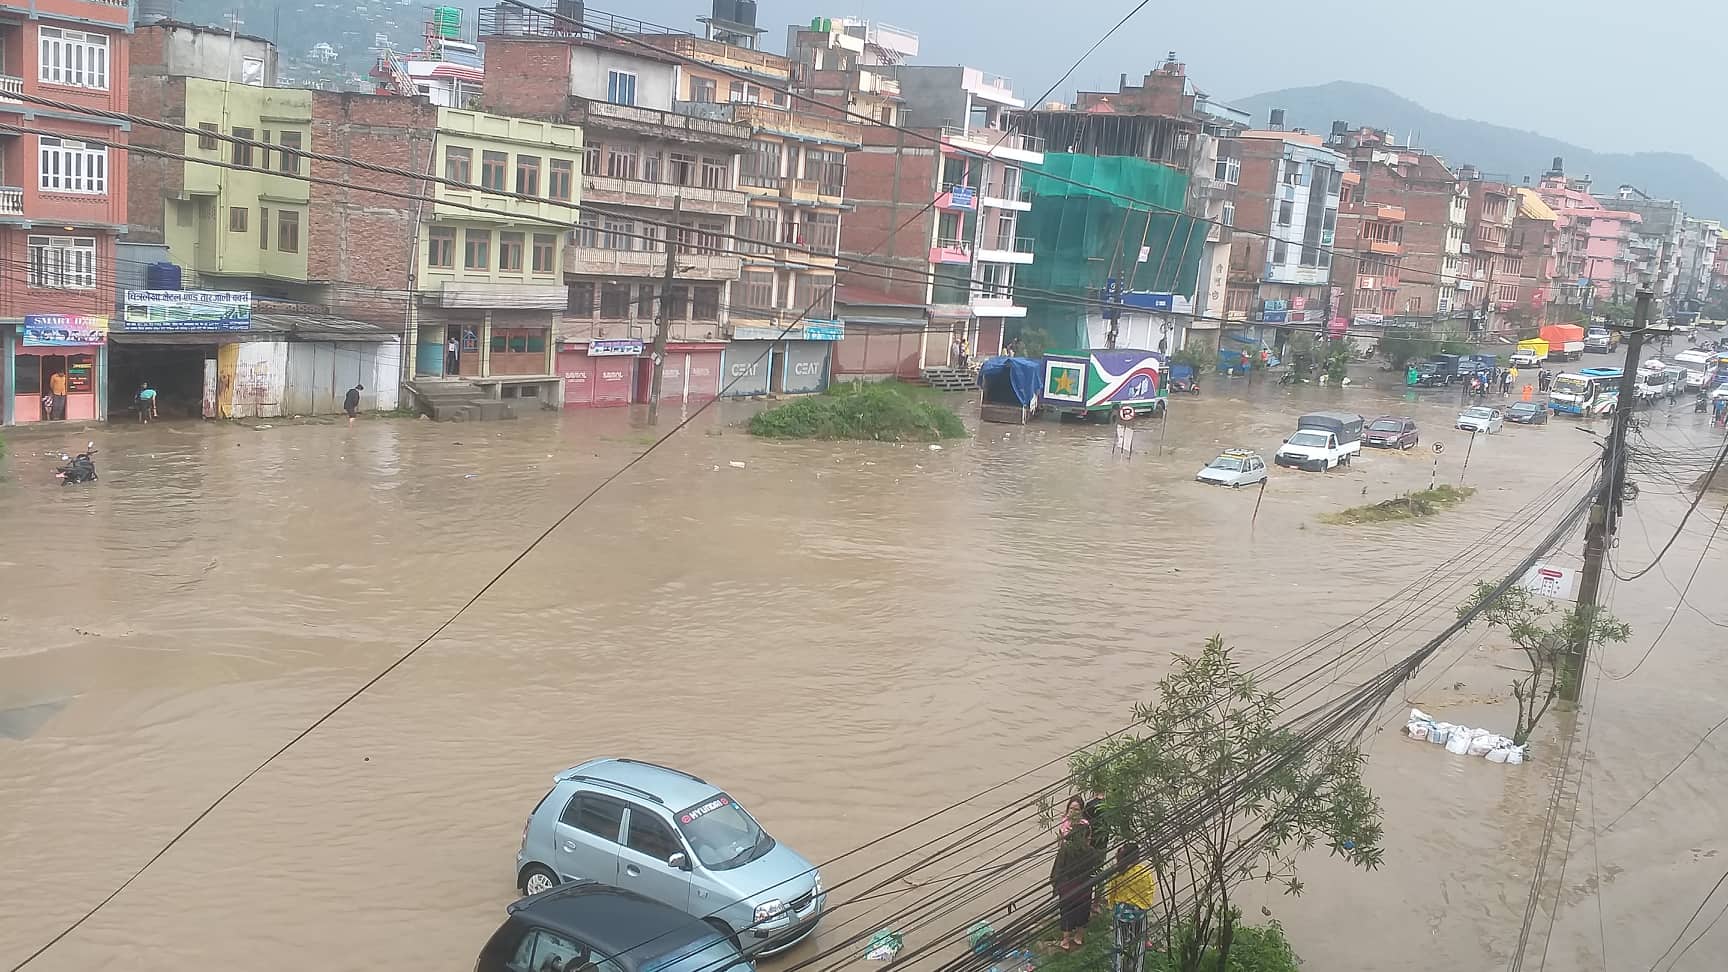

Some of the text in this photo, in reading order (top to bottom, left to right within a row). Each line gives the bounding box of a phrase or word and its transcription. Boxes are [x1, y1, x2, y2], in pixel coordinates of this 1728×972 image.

[34, 317, 70, 325] SMART
[731, 362, 758, 377] CEAT
[795, 362, 819, 375] CEAT
[689, 799, 723, 820] HYUNDAI
